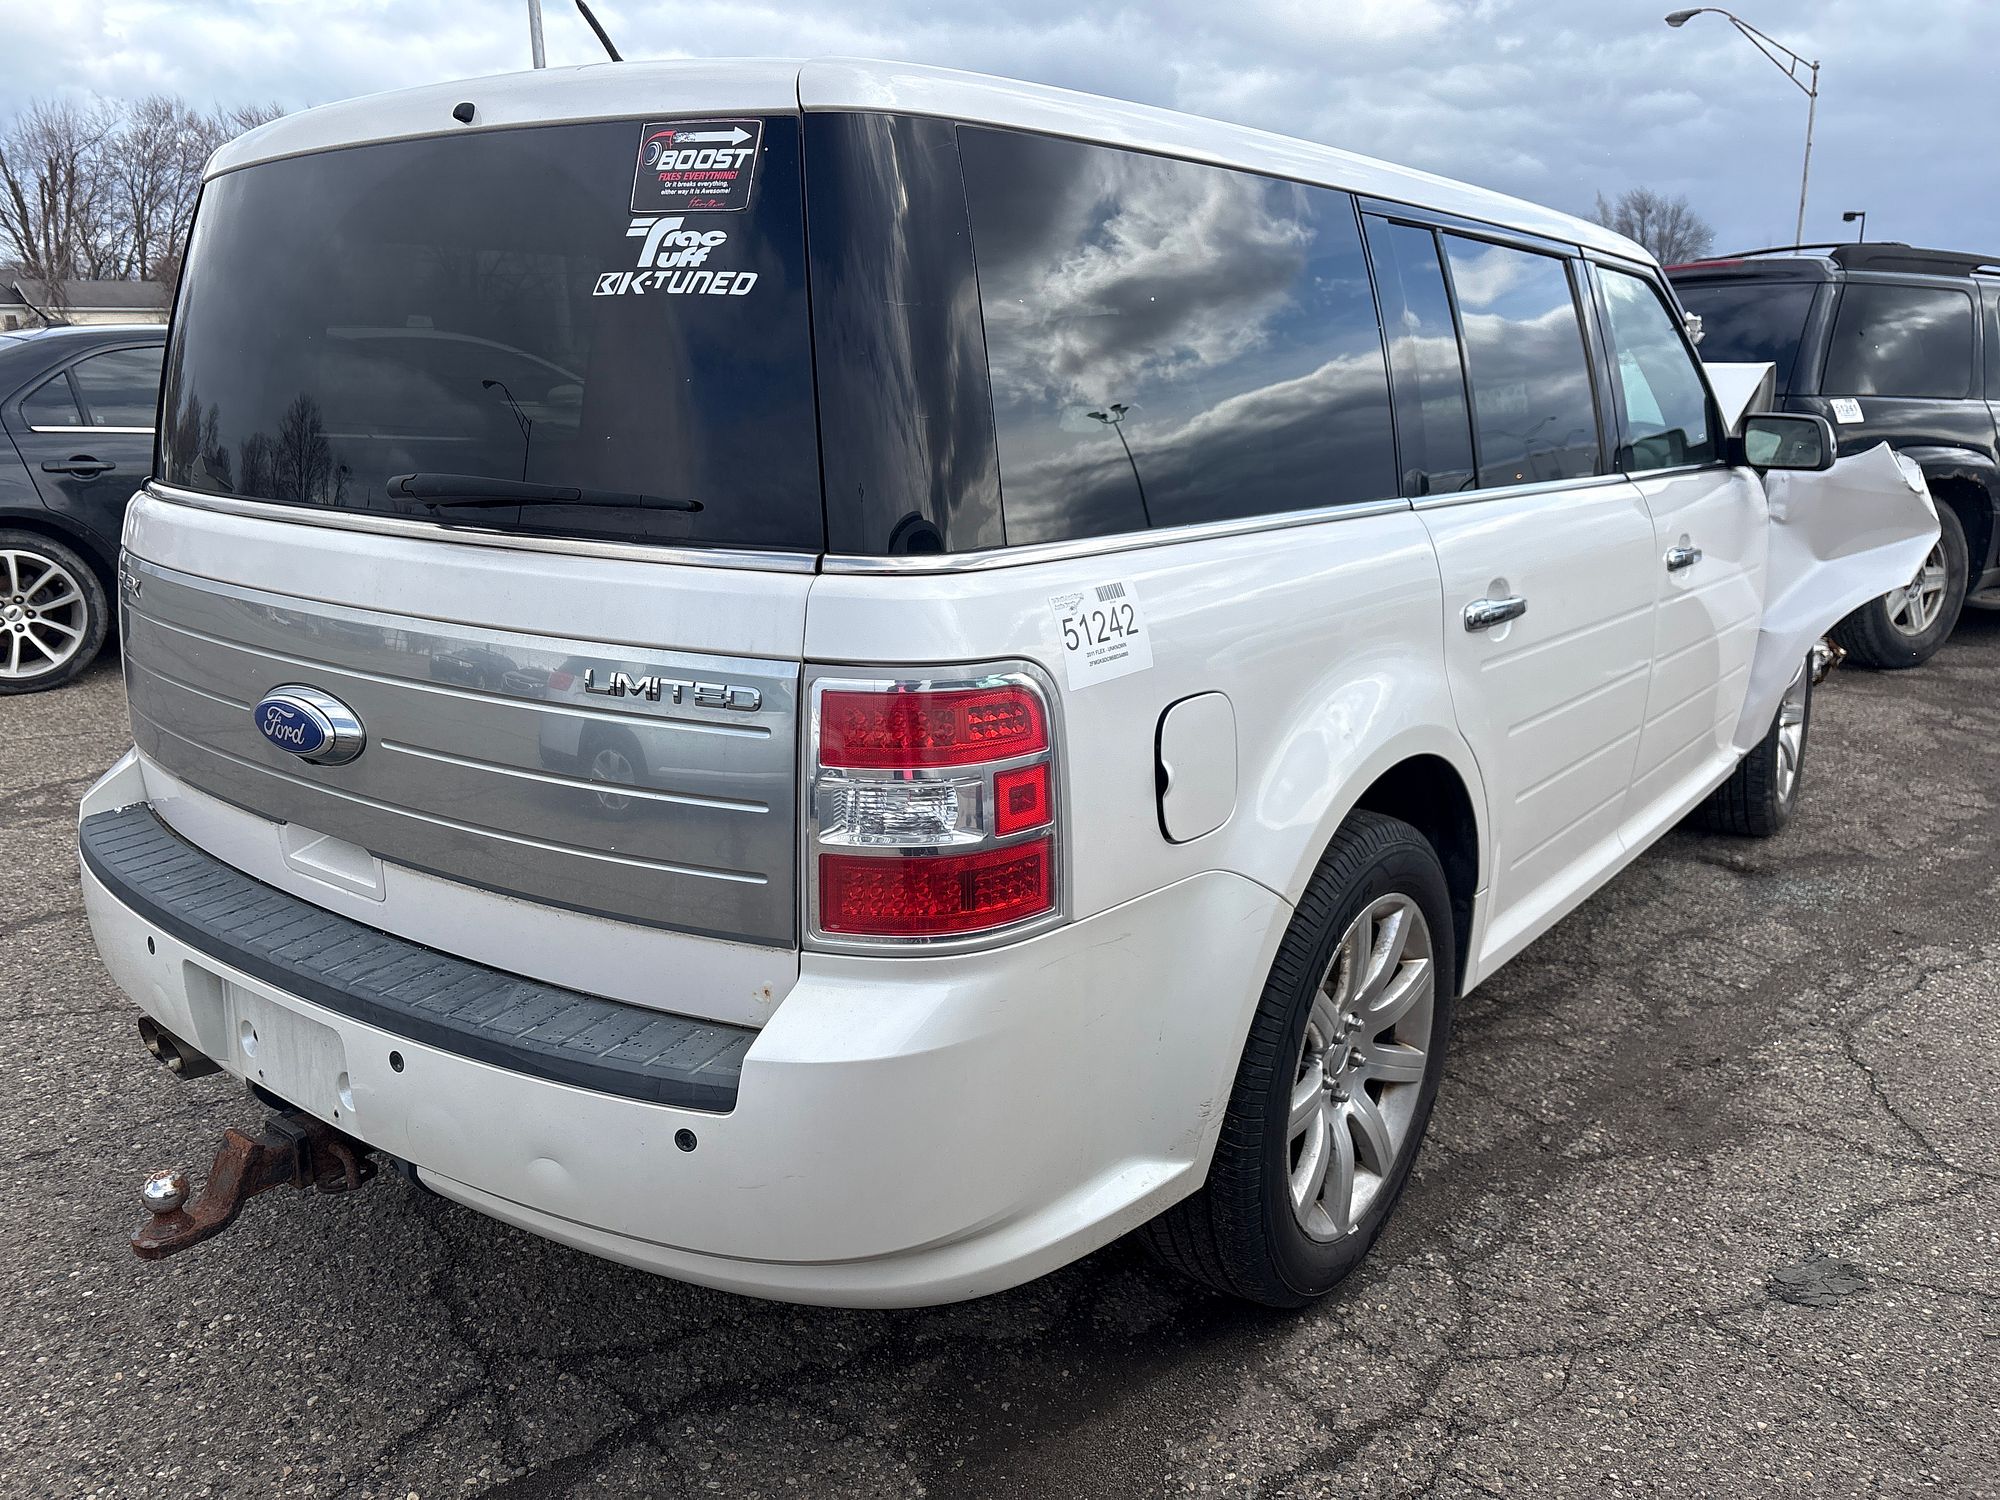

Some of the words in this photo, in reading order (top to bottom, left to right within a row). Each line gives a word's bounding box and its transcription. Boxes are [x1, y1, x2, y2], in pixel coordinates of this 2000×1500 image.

[656, 149, 754, 170] BOOST
[658, 172, 682, 181] FIXES
[683, 171, 739, 181] EVERYTHING!
[677, 189, 689, 197] way
[701, 187, 731, 195] Awesome!
[1062, 603, 1139, 651] 51242
[584, 668, 762, 712] LIMITED
[264, 706, 305, 745] Ford
